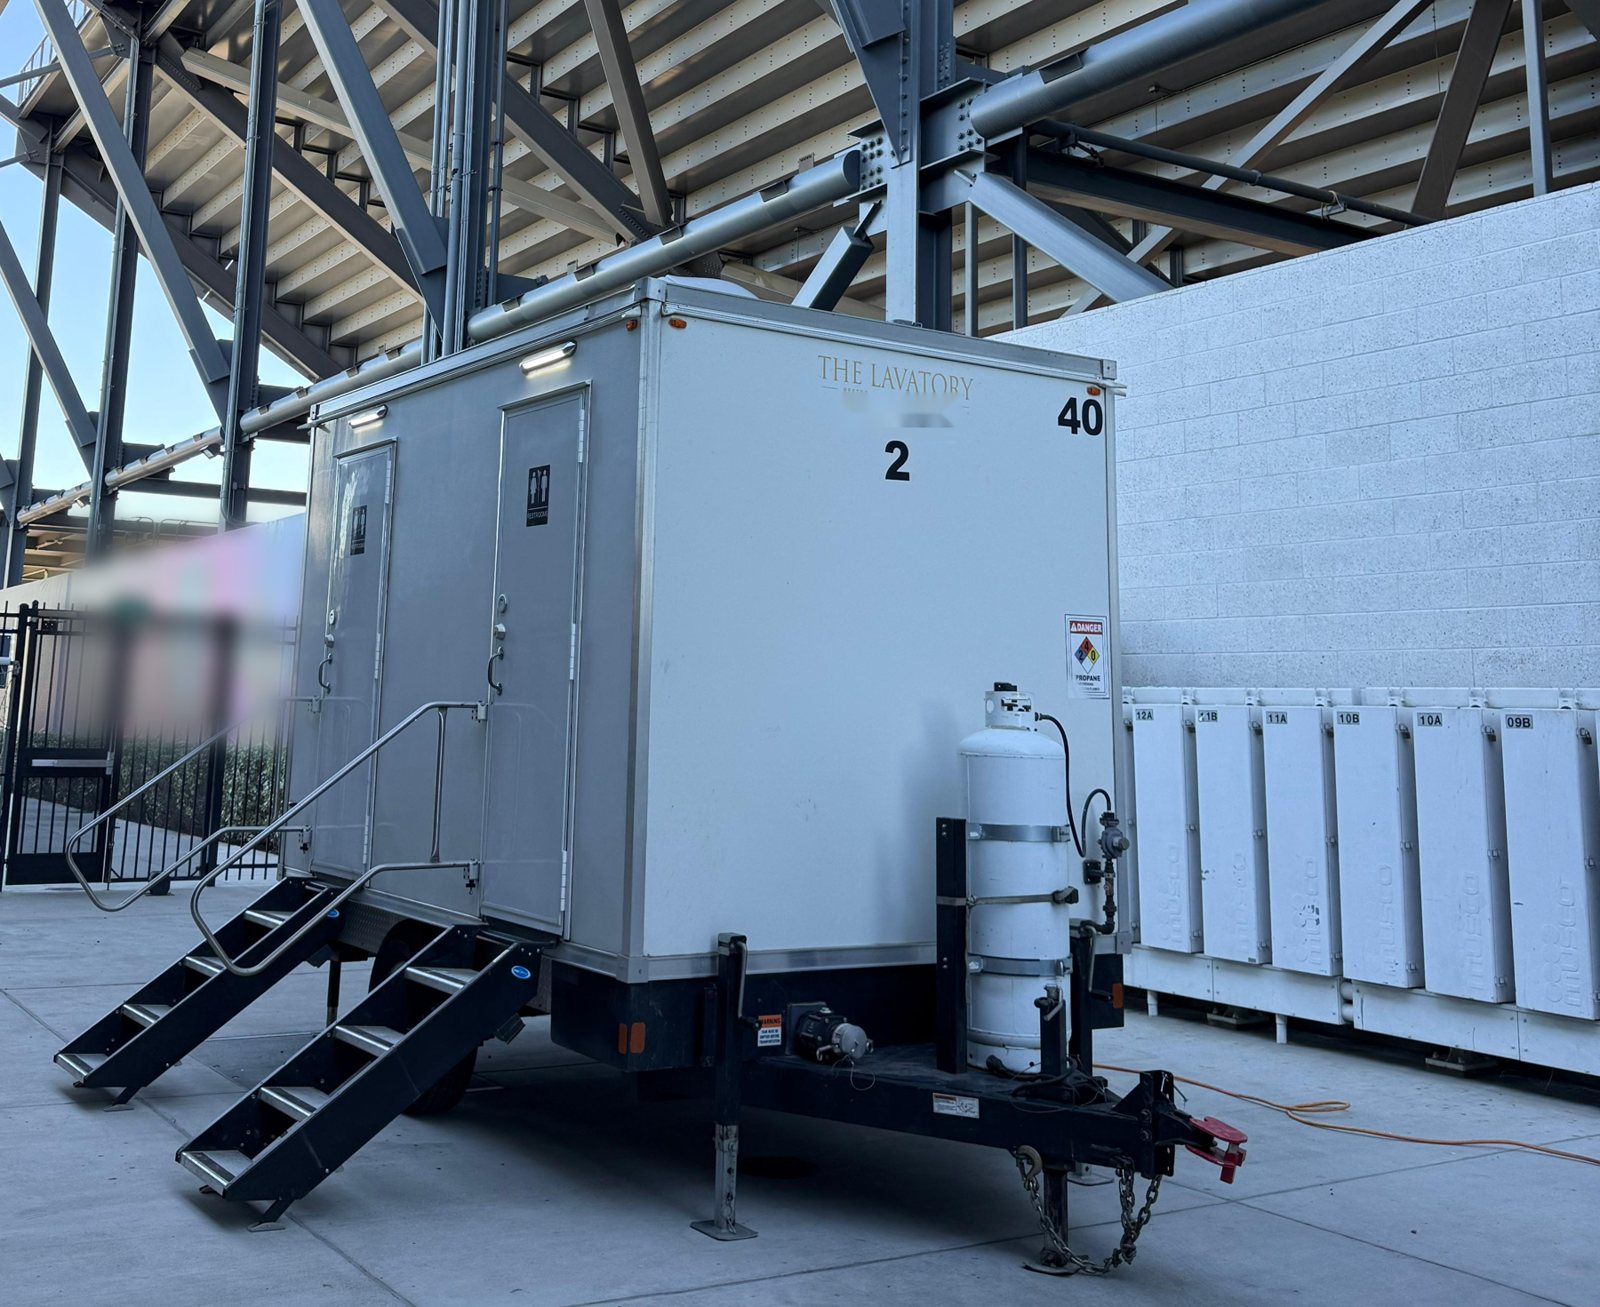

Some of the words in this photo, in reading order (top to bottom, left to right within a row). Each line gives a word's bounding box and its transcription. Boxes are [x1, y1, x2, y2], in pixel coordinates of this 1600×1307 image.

[818, 355, 862, 385] THE
[872, 363, 973, 400] LAVATORY
[1057, 397, 1103, 436] 40
[884, 440, 910, 481] 2
[1076, 623, 1102, 633] DANGER
[1075, 674, 1101, 682] PROPANE
[1136, 711, 1153, 720] 12A
[1269, 713, 1287, 723] 11A
[1339, 713, 1360, 724] 10B
[1419, 715, 1442, 726] 10A
[1507, 716, 1531, 728] 09B
